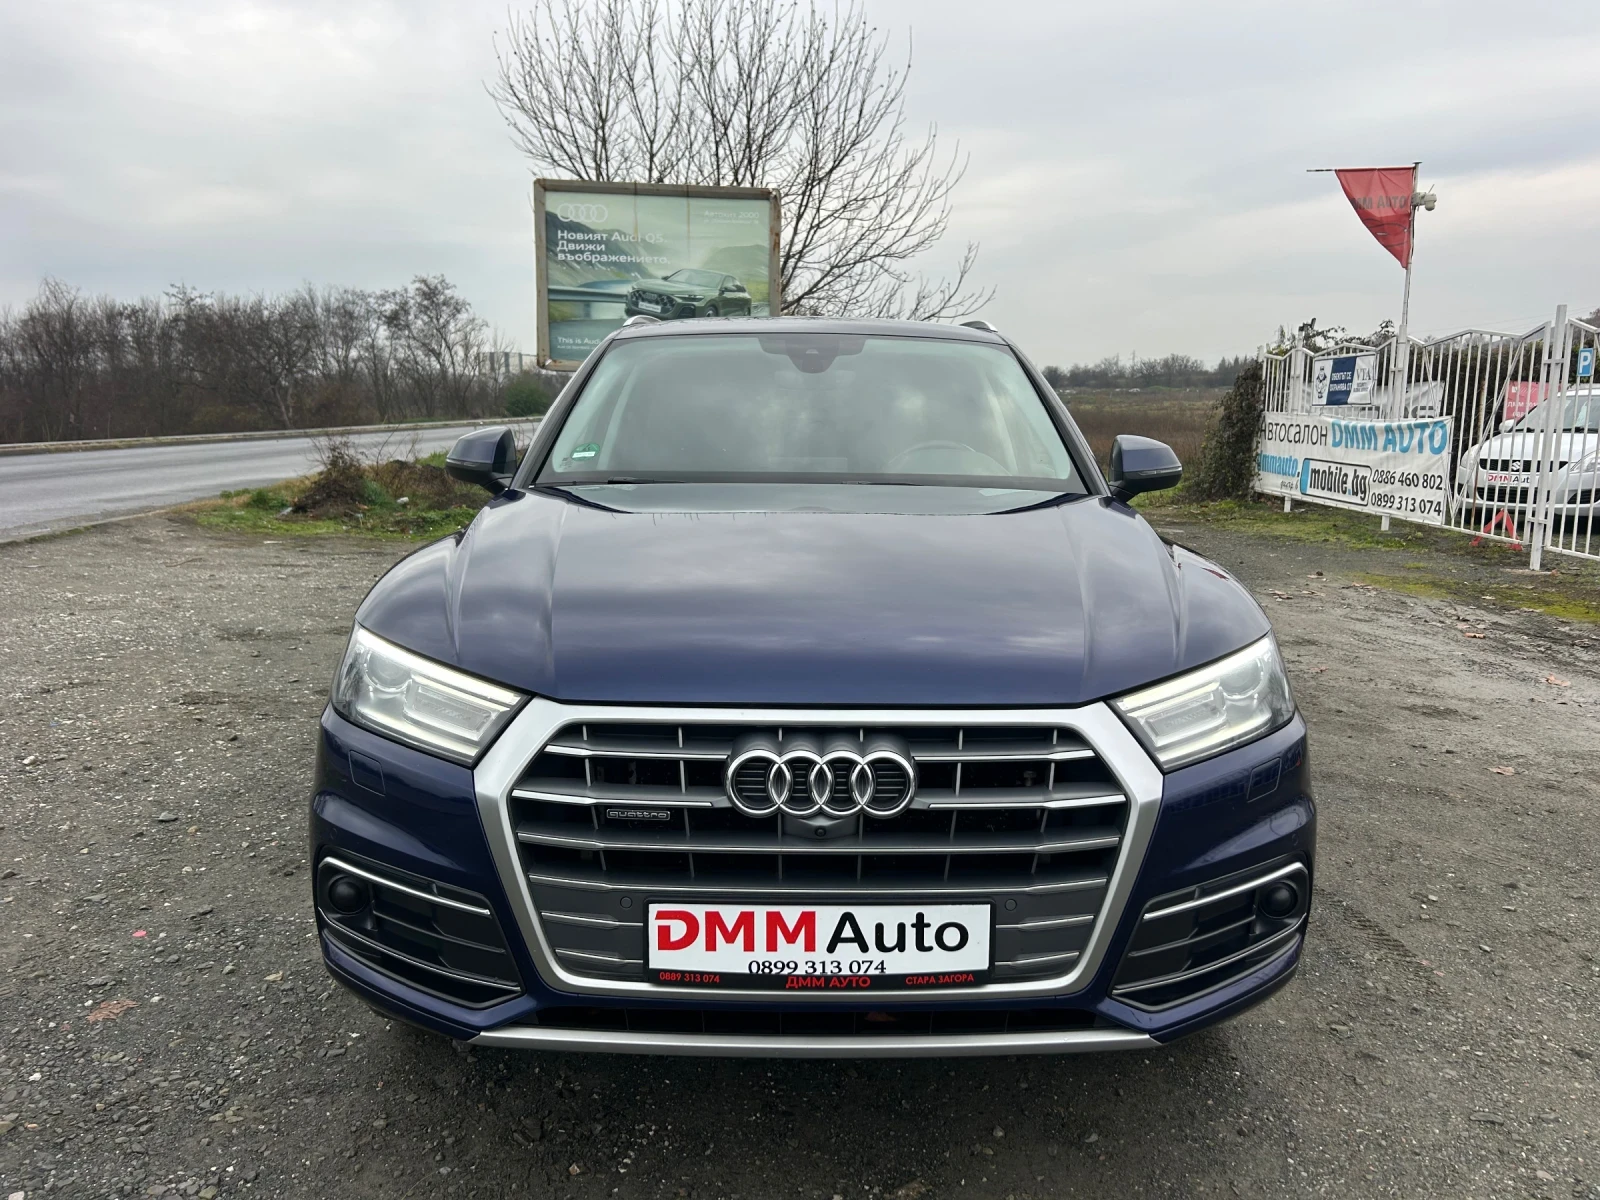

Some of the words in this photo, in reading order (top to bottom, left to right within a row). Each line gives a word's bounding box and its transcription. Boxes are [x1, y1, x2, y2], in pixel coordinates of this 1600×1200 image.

[557, 230, 608, 241] Новият
[556, 241, 606, 252] Движи
[557, 252, 671, 265] въображението.
[557, 336, 573, 344] This
[1579, 351, 1591, 374] P
[1260, 419, 1328, 447] Автосалон
[1331, 419, 1378, 451] DMM
[1383, 421, 1448, 455] AUTO
[1309, 465, 1367, 501] mobile.bg
[1372, 469, 1396, 485] 0886
[1398, 472, 1419, 487] 460
[1422, 474, 1443, 490] 802
[1371, 492, 1395, 508] 0899
[1396, 496, 1416, 512] 313
[1419, 499, 1442, 516] 074
[609, 811, 667, 819] quattro
[747, 960, 799, 974] 0899
[805, 960, 842, 974] 313
[849, 960, 886, 974] 074
[659, 971, 681, 981] 0889
[684, 973, 700, 983] 313
[703, 974, 720, 983] 074
[785, 976, 825, 989] ДММ
[829, 976, 871, 988] АУТО
[905, 975, 936, 986] СТАРА
[938, 973, 975, 984] ЗАГОРА
